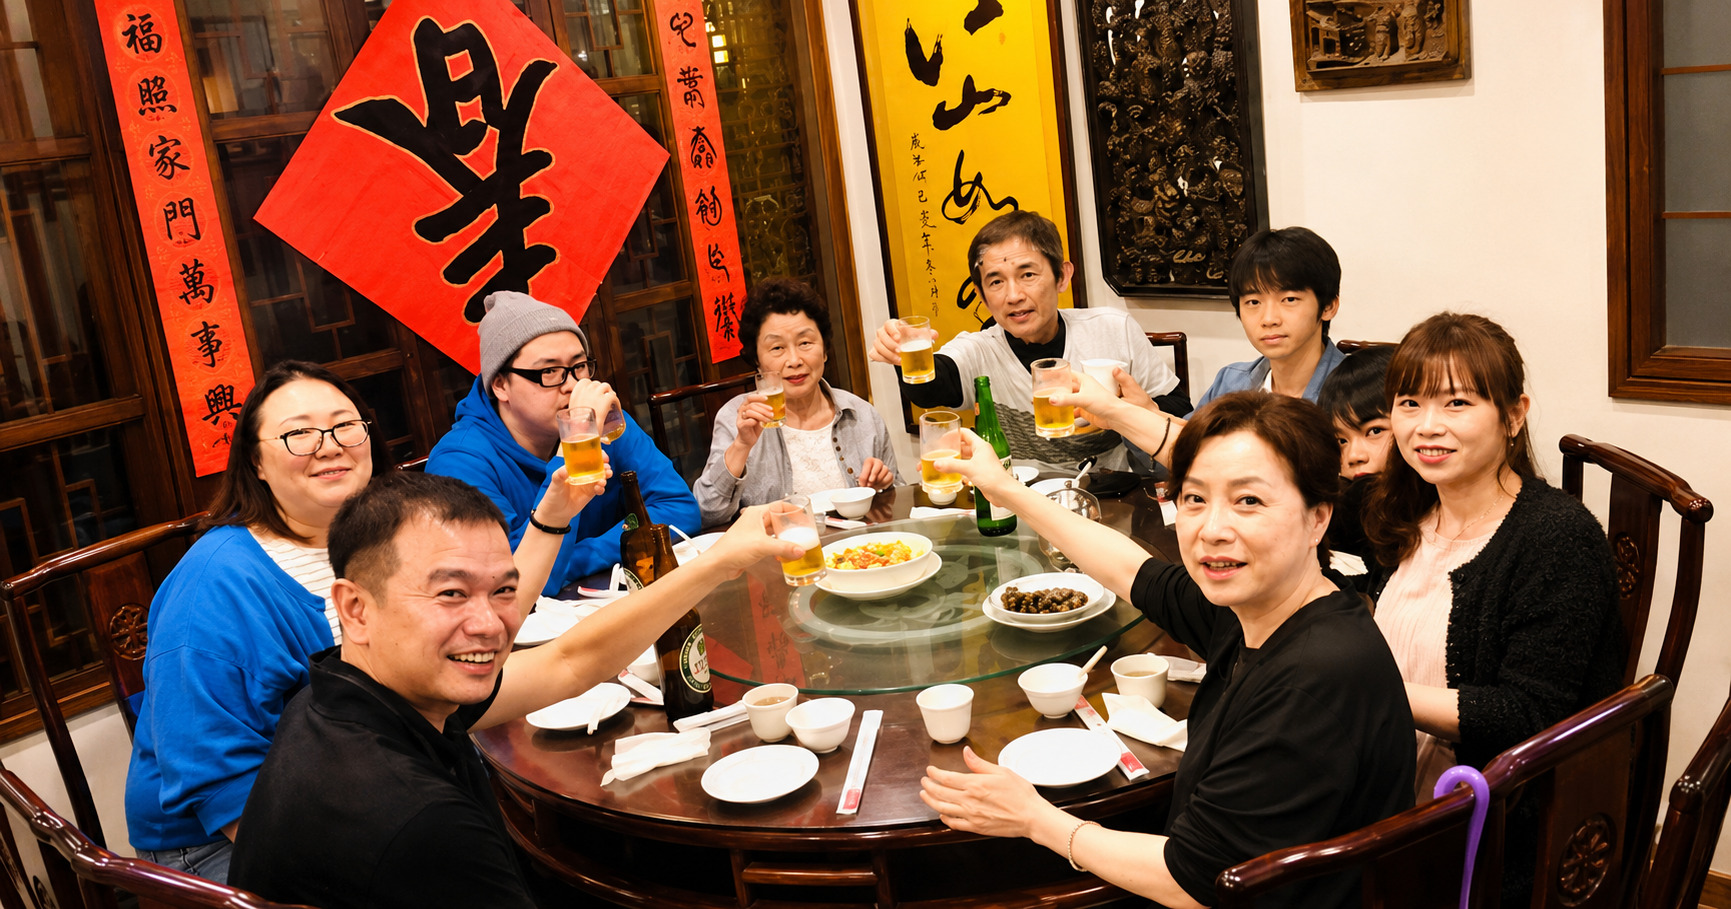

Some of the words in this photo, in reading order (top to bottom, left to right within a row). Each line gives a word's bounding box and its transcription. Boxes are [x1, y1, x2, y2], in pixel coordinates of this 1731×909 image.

[121, 13, 243, 426] 福照家門萬事興
[331, 17, 558, 325] 春
